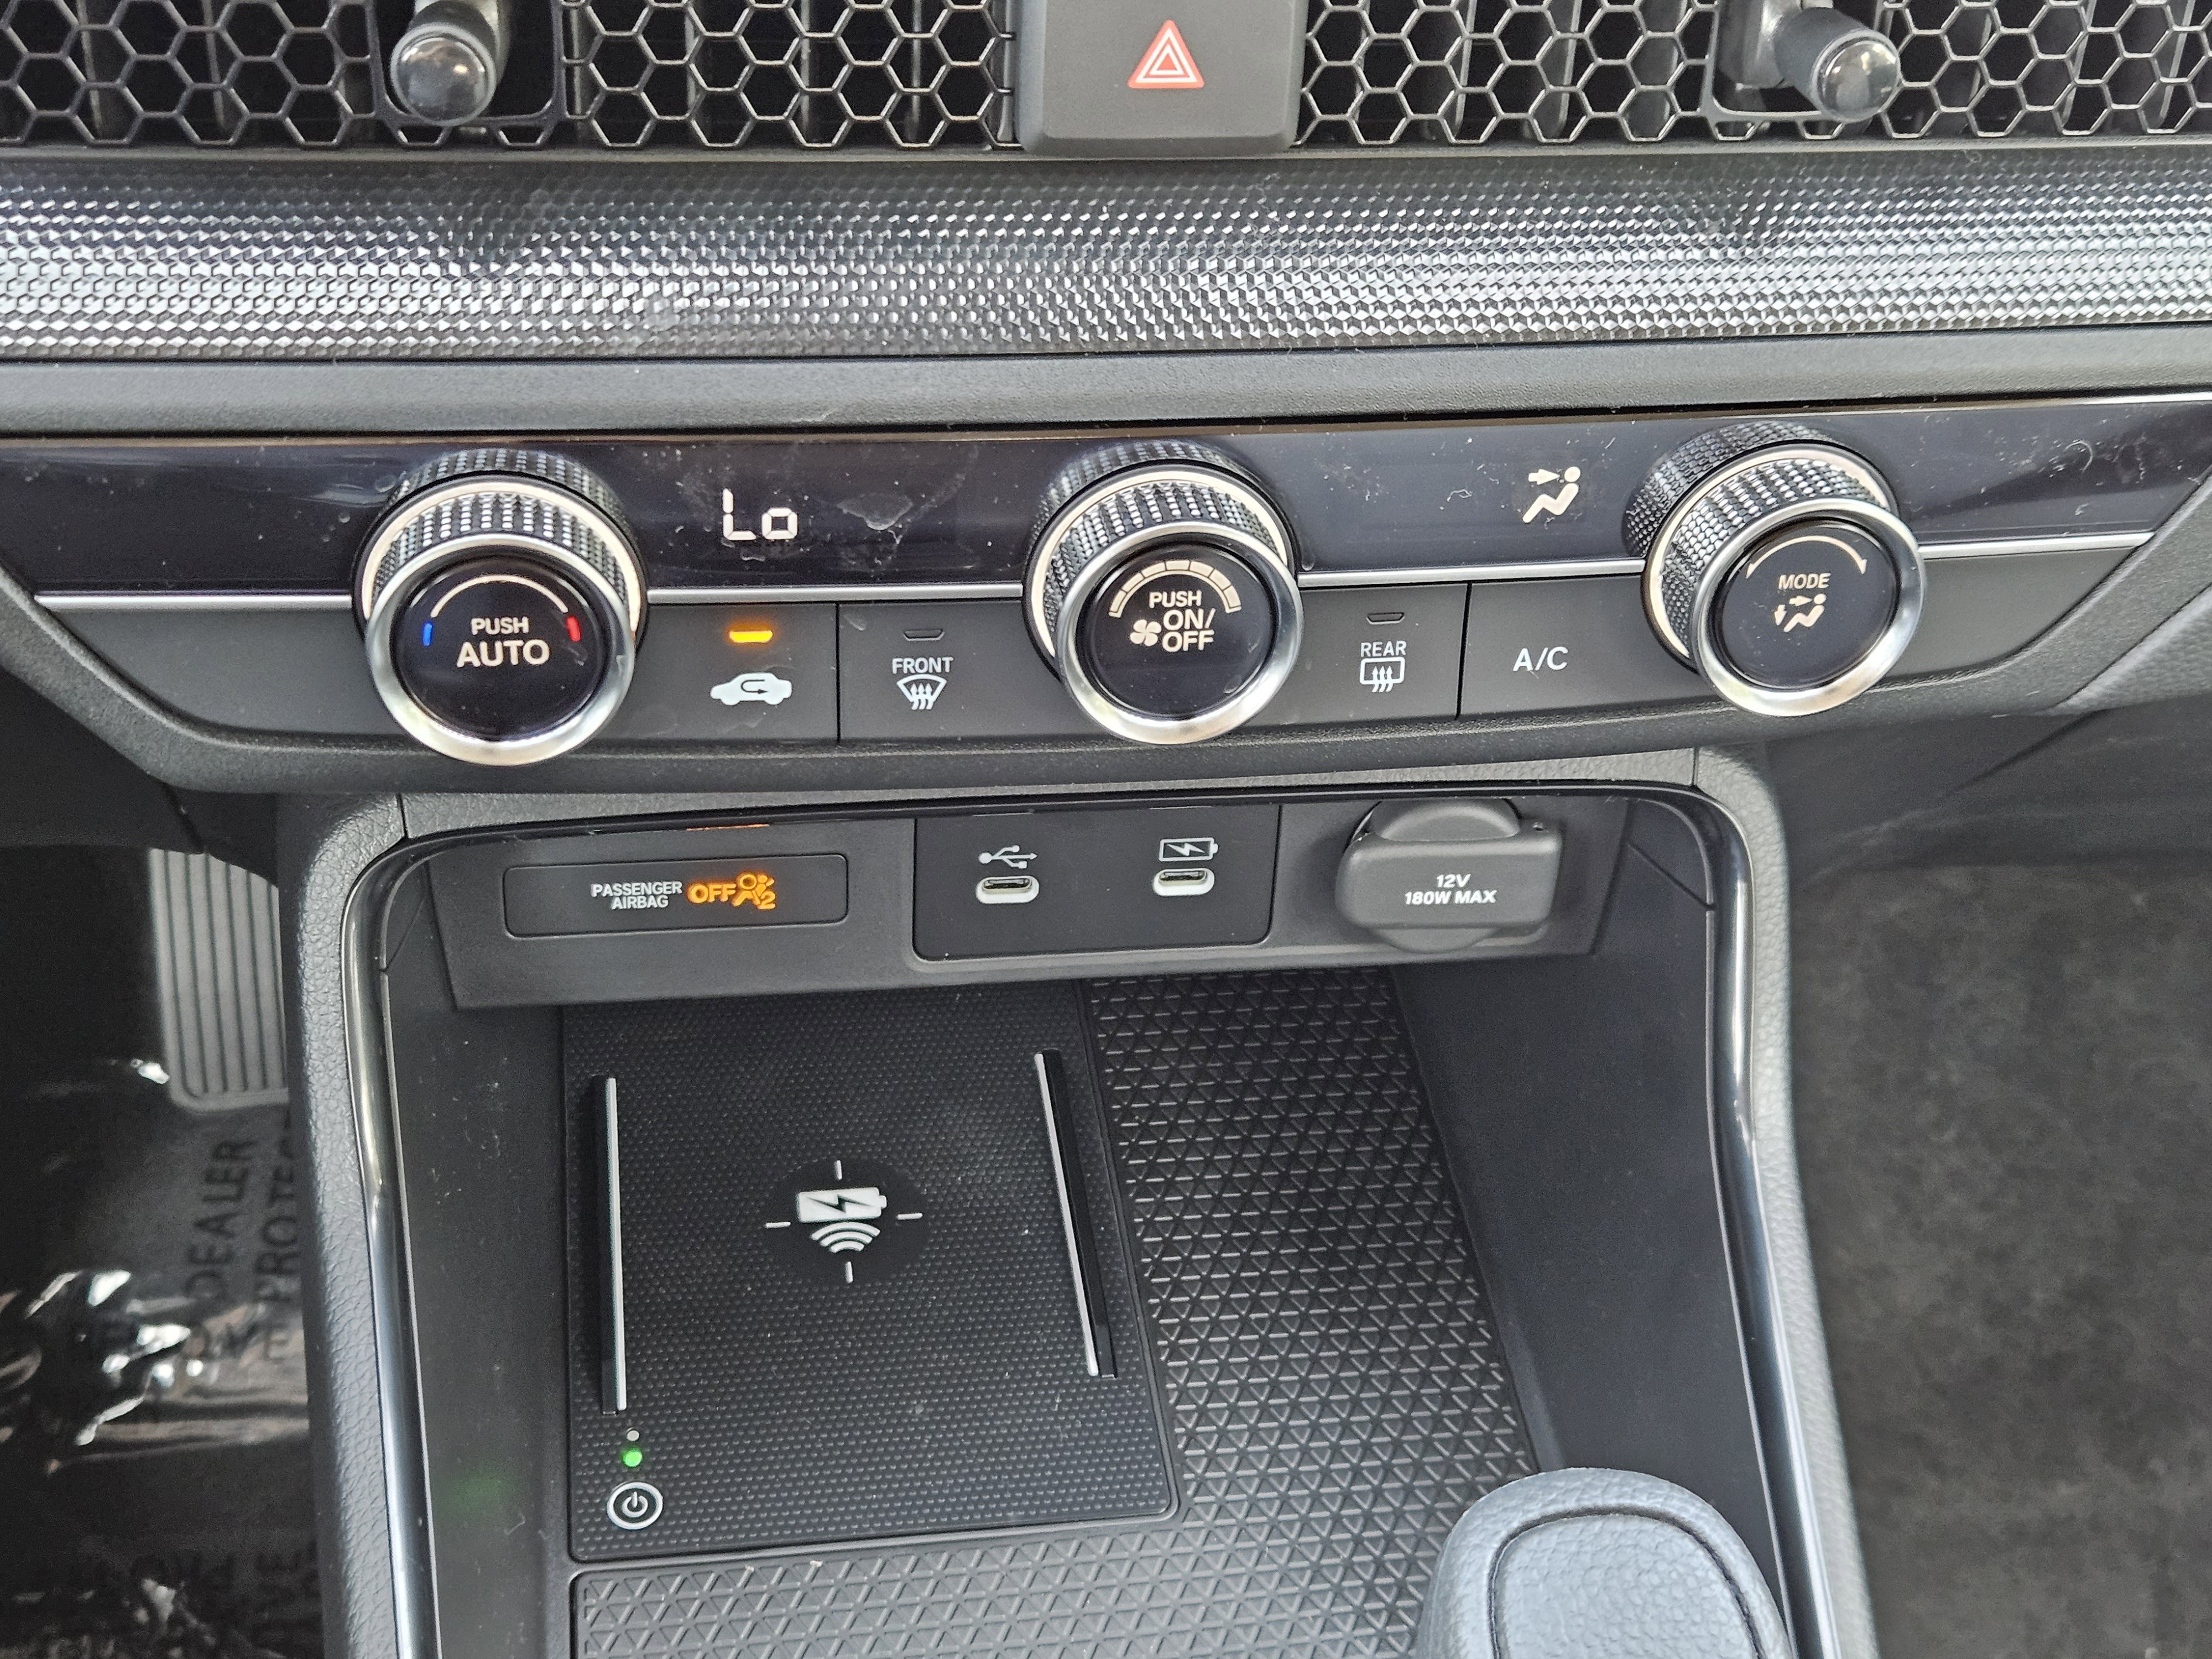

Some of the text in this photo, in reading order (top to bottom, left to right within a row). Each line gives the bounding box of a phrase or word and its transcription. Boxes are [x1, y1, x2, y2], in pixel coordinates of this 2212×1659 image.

[722, 488, 799, 541] Lo
[1778, 573, 1832, 589] MODE
[1149, 589, 1202, 608] PUSH
[471, 616, 529, 635] PUSH
[1163, 608, 1216, 630] ON/
[1162, 629, 1215, 653] OFF
[1360, 640, 1407, 657] REAR
[457, 639, 550, 667] AUTO
[1512, 646, 1569, 672] A/C
[892, 656, 954, 674] FRONT
[591, 881, 682, 897] PASSENGER
[1436, 873, 1472, 888] 12V
[611, 895, 669, 910] AIRBAG
[687, 883, 737, 904] OFF
[1405, 889, 1498, 905] 180W MAX
[184, 1140, 257, 1302] DEALER
